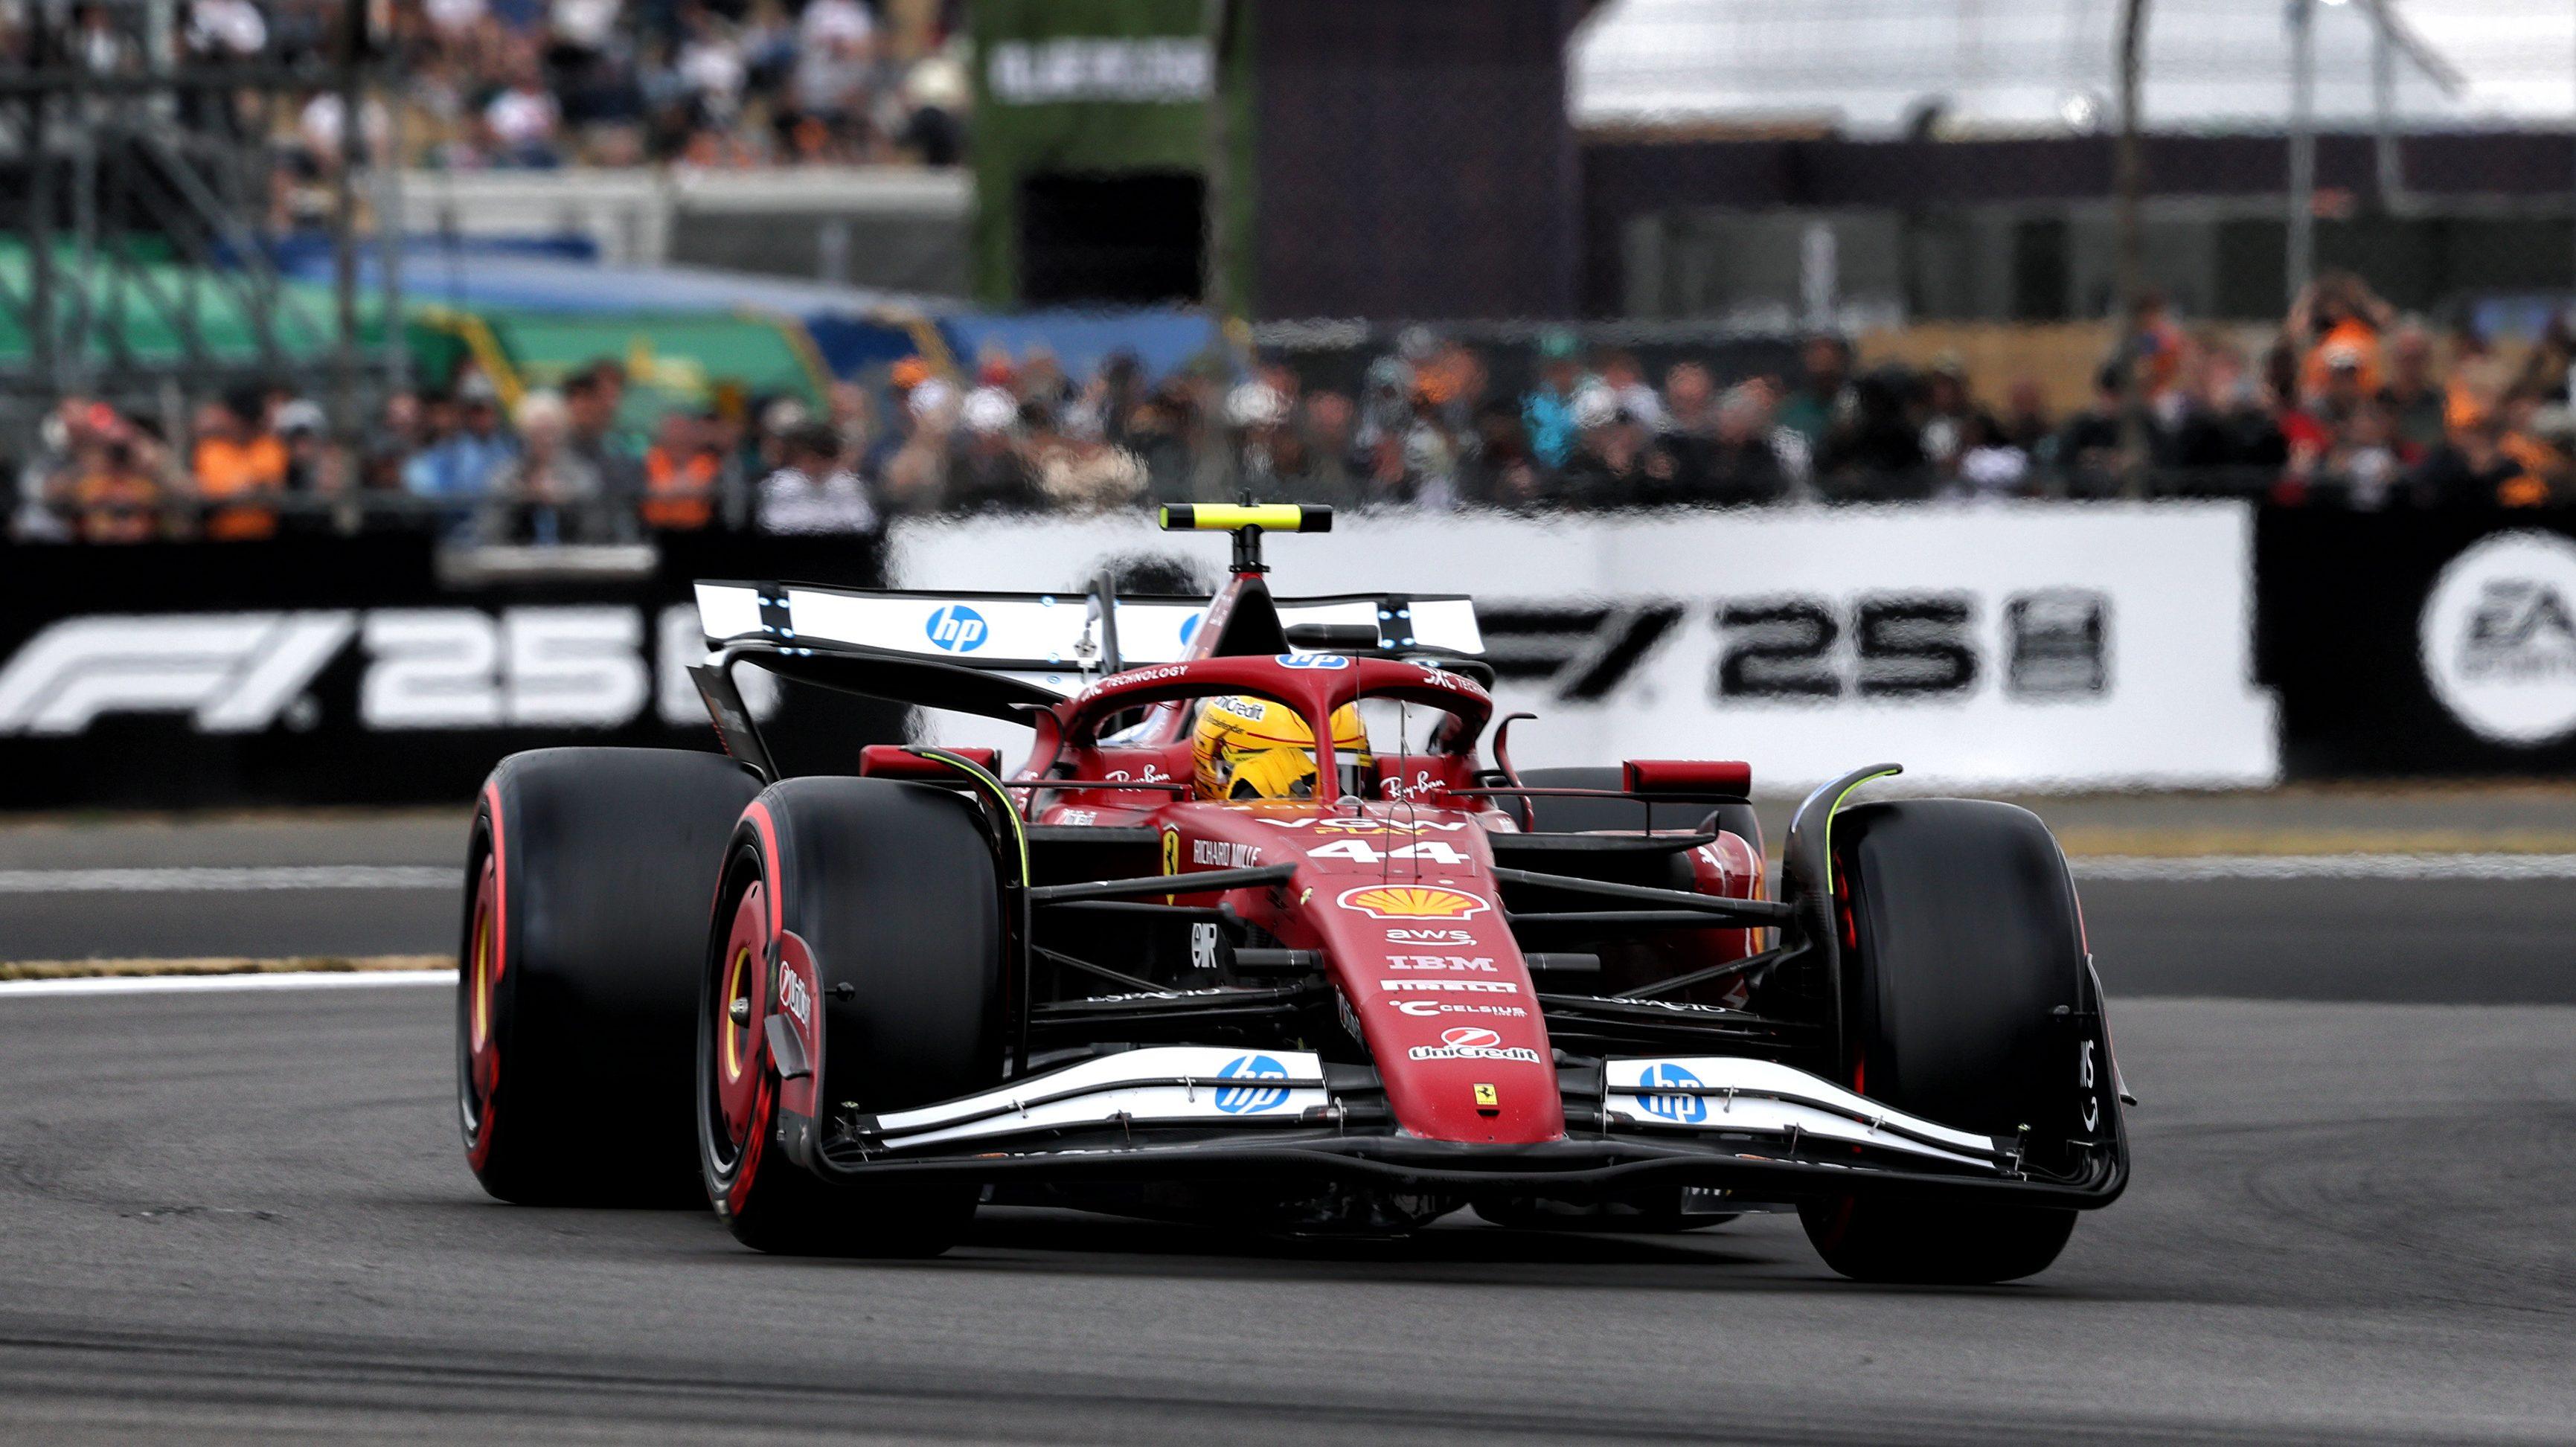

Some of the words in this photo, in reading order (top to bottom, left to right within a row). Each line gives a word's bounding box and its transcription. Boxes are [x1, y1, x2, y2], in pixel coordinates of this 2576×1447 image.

[930, 604, 984, 652] hp
[1715, 595, 1979, 698] 25
[360, 606, 649, 729] 25
[1106, 665, 1188, 687] TECHNOLOGY
[1105, 764, 1171, 792] Ry-Ban
[1380, 770, 1446, 799] Ray-Ban
[1255, 818, 1469, 831] VGW
[1314, 827, 1431, 836] PLAY
[1194, 839, 1231, 866] RICHARD
[1231, 842, 1263, 868] MILLE
[1305, 839, 1471, 864] 44
[1386, 929, 1471, 940] aws
[1385, 955, 1498, 972] IBM
[1380, 979, 1517, 992] PIRELLI
[1439, 1004, 1527, 1015] CELSIUS
[1411, 1045, 1539, 1062] UniCredit
[1218, 1055, 1286, 1114] hp
[1643, 1064, 1702, 1123] hp
